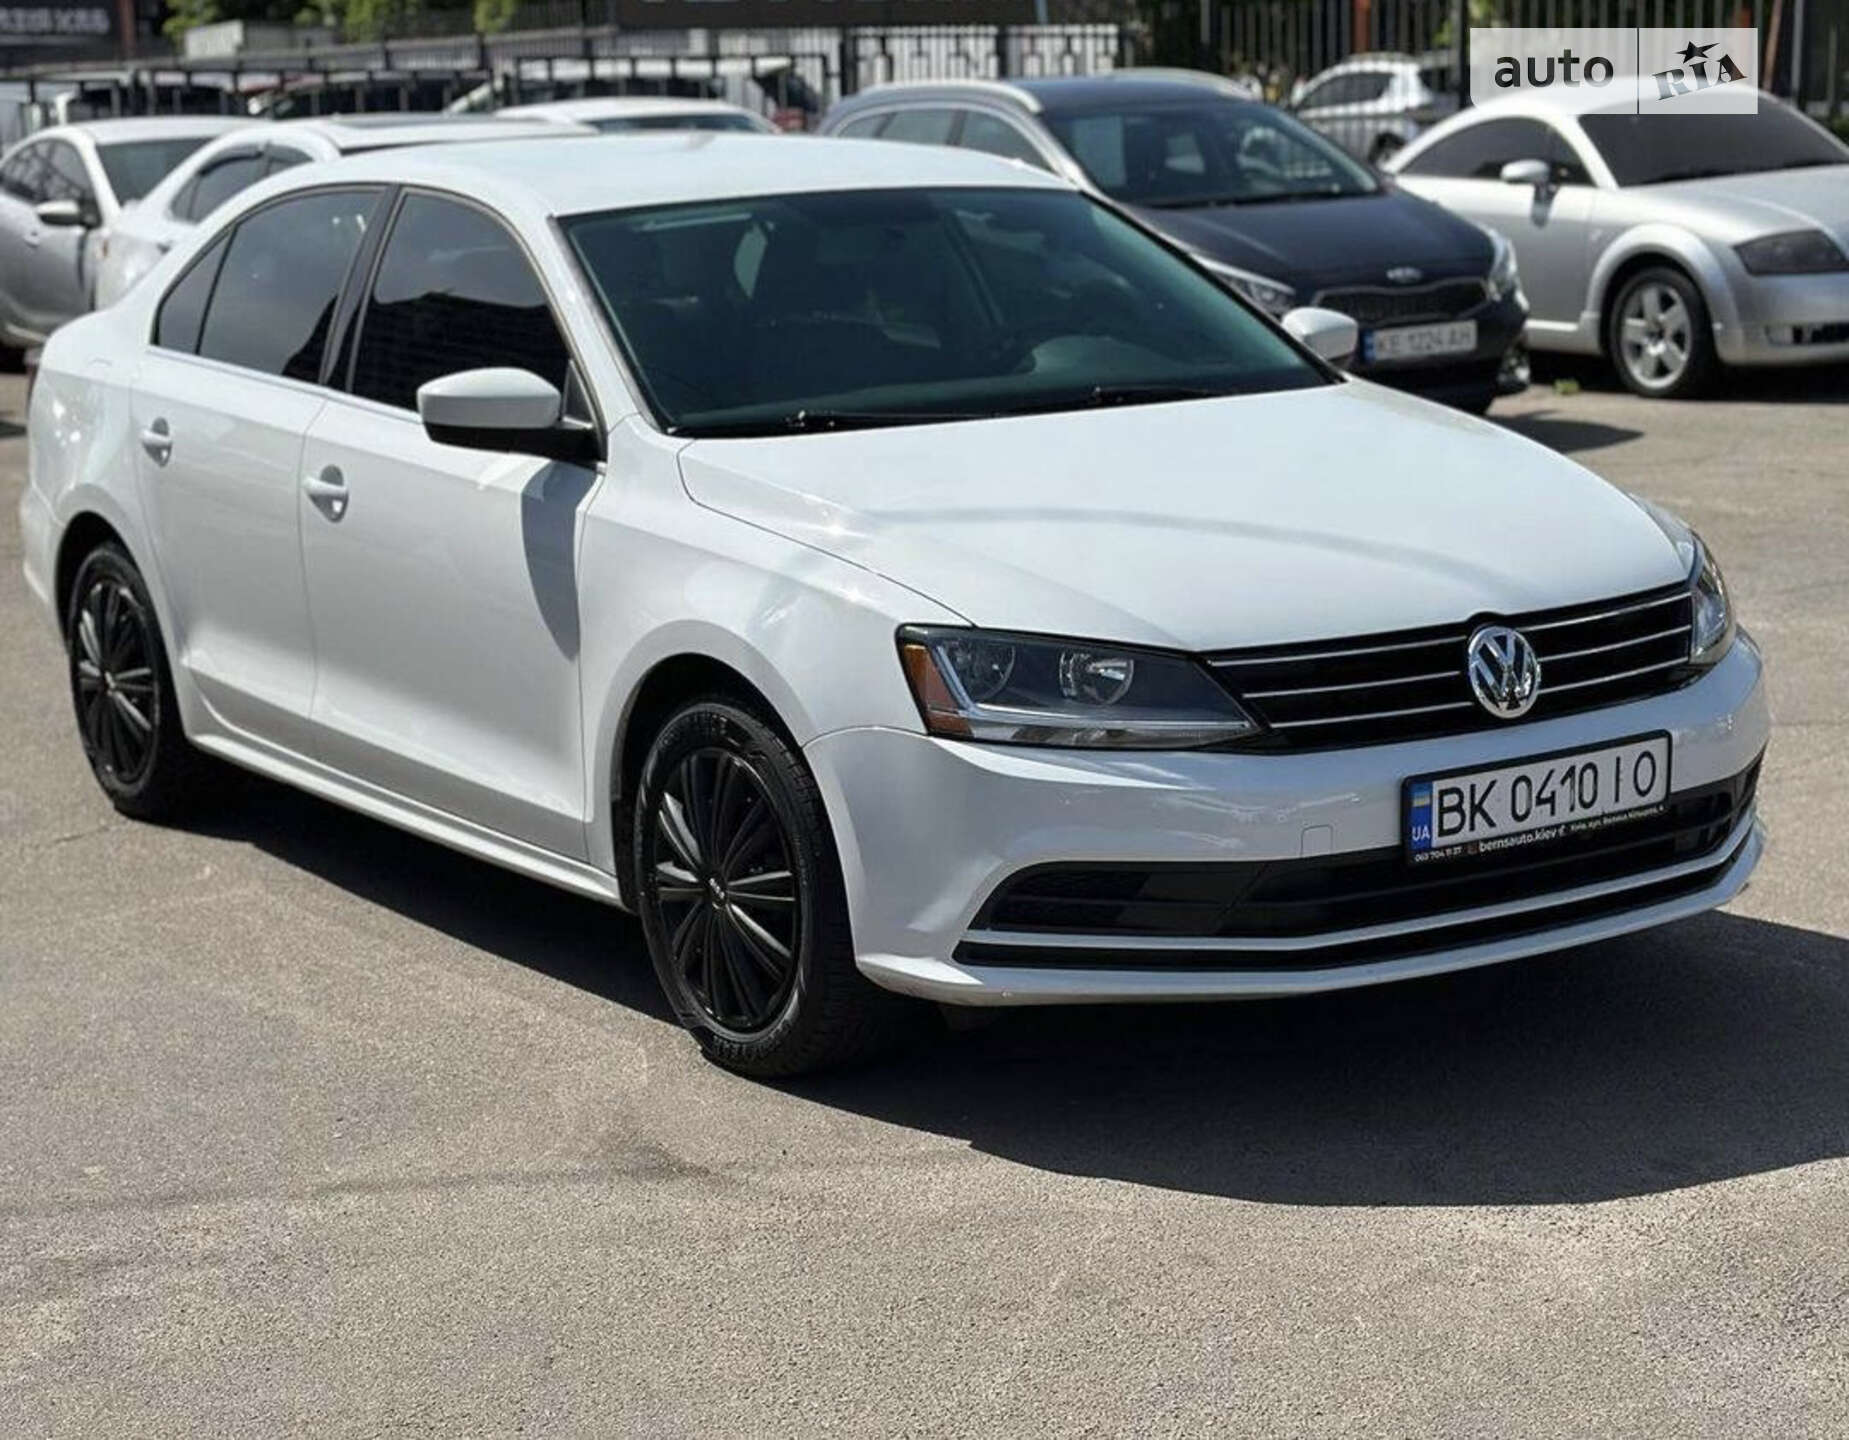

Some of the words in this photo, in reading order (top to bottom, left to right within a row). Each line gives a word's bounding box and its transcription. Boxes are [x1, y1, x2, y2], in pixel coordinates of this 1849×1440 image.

[1438, 779, 1498, 838] BK
[1511, 761, 1598, 823] 0410
[1411, 825, 1431, 841] UA
